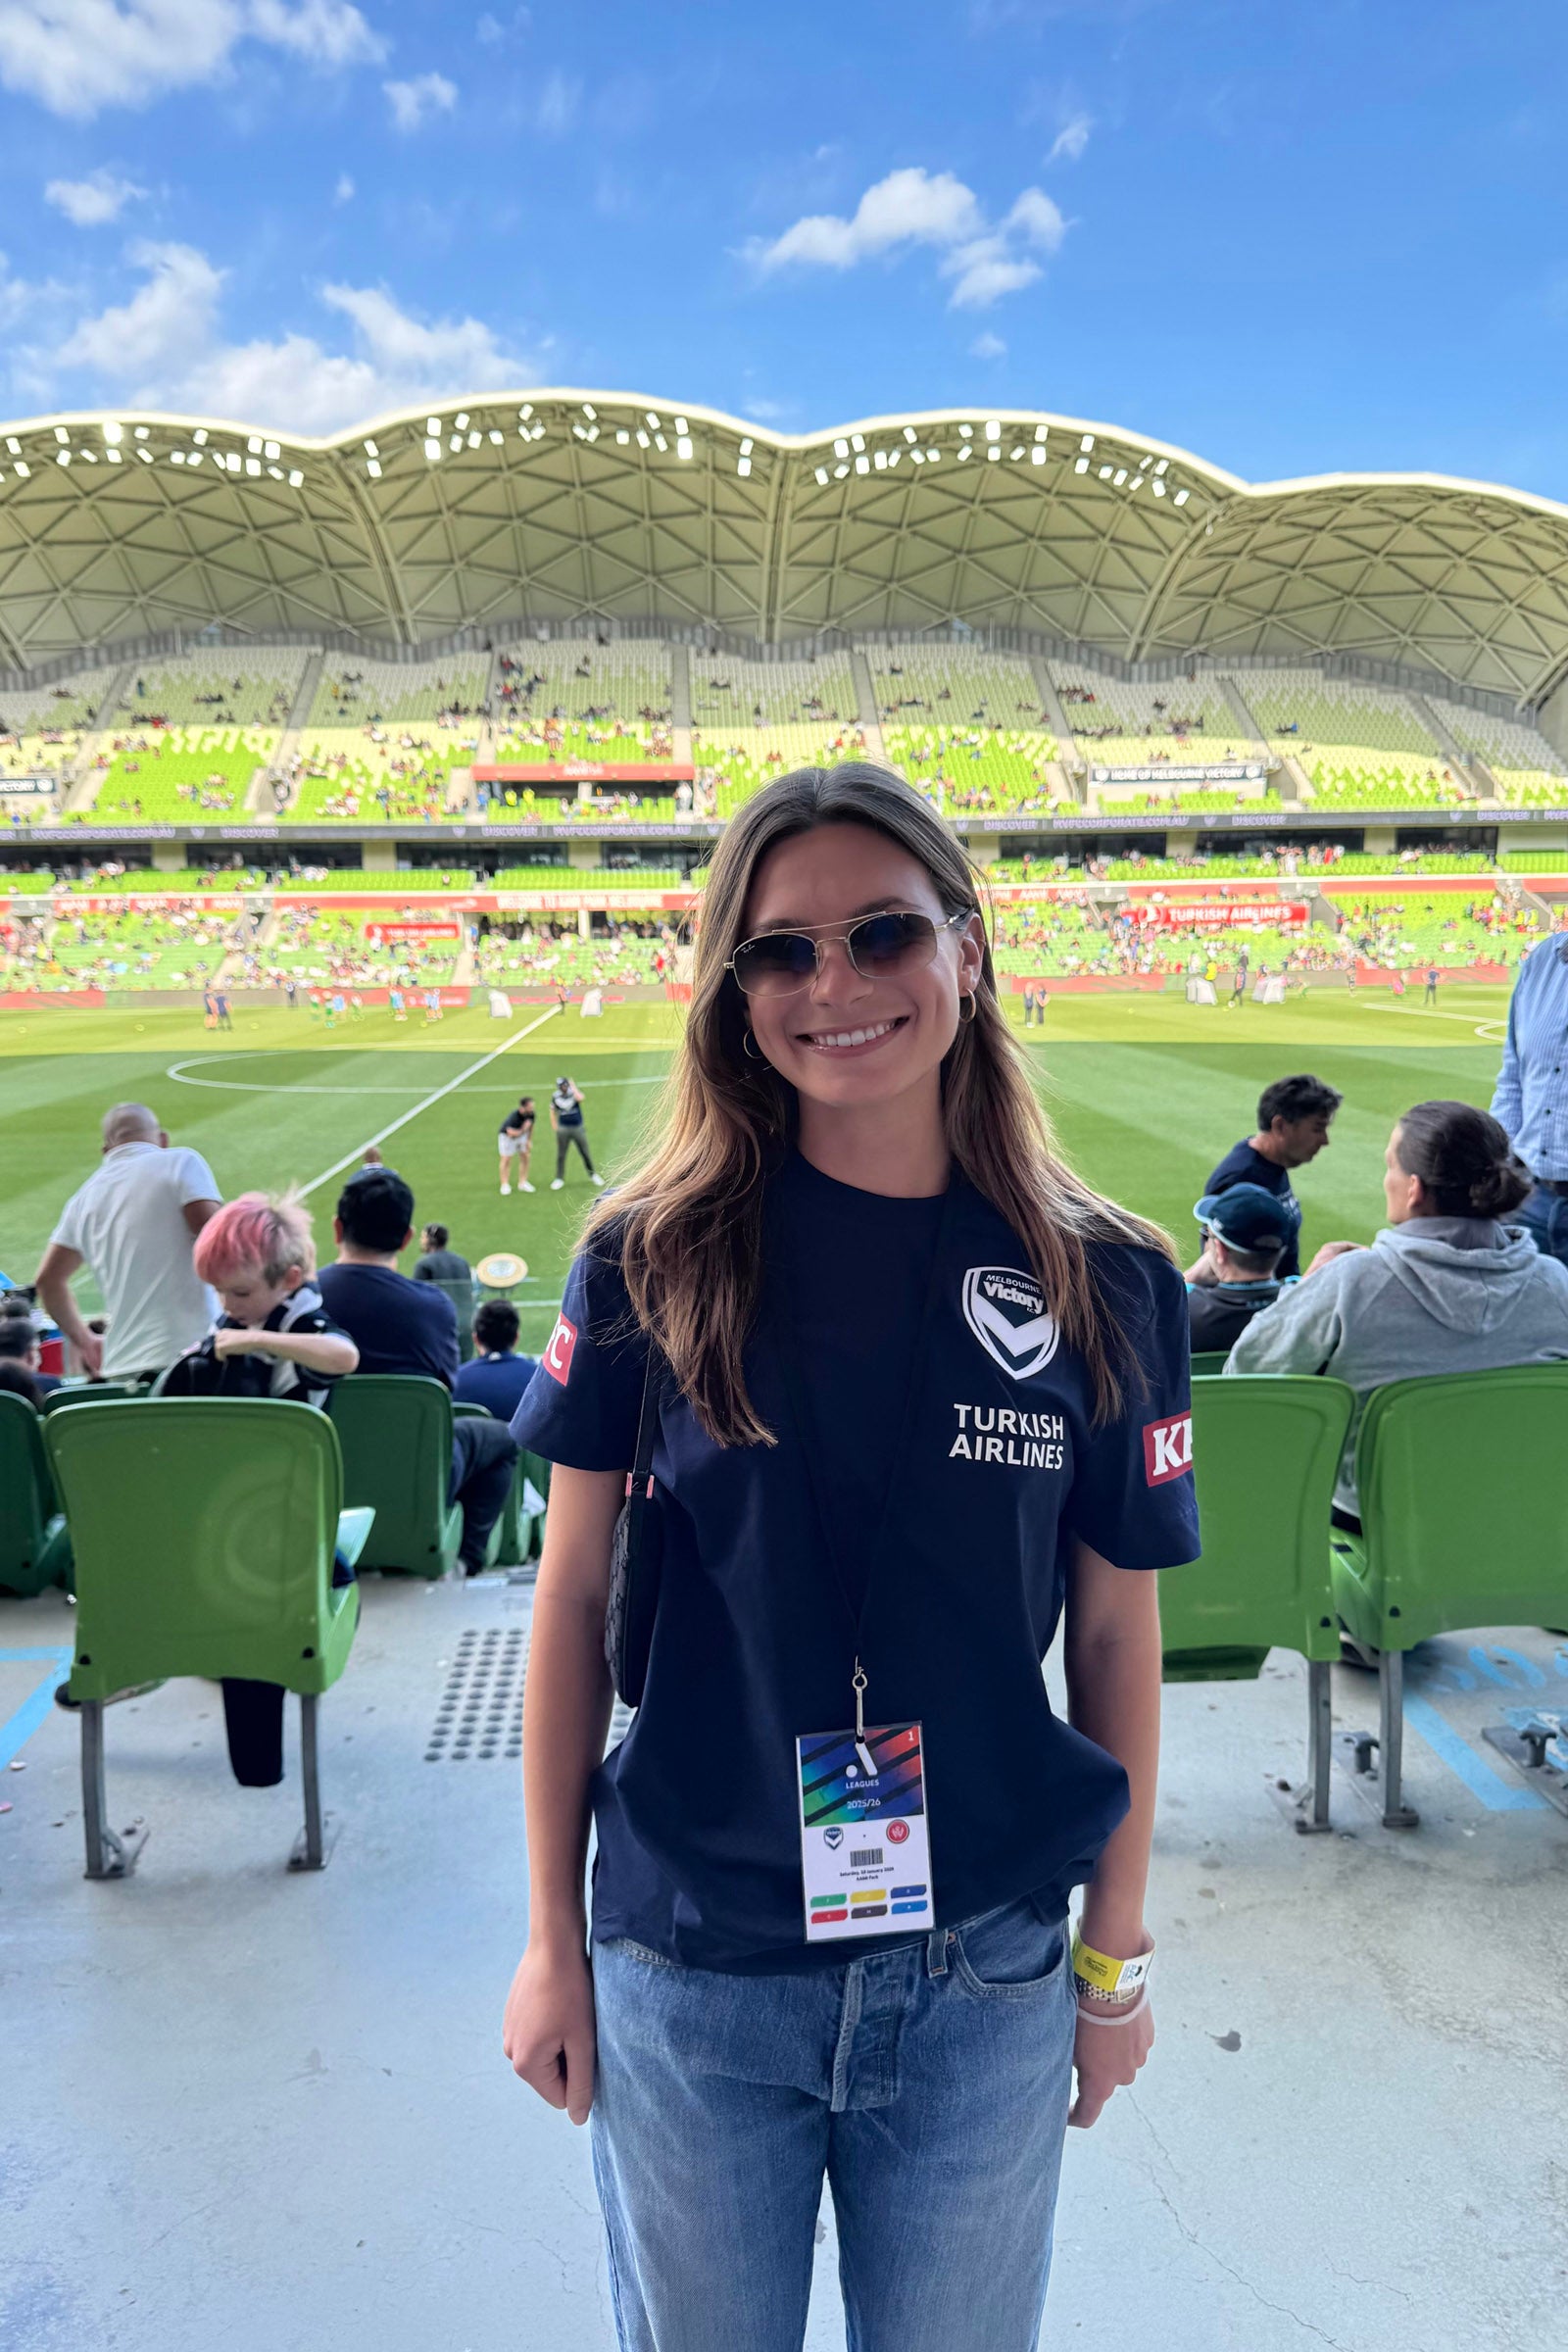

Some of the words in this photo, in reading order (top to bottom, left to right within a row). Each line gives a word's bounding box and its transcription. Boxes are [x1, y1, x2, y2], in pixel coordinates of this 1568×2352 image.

[1110, 769, 1136, 780] HOME
[1138, 768, 1151, 780] OF
[1205, 766, 1246, 779] VICTORY
[1232, 814, 1287, 826] DISCOVER
[1169, 907, 1229, 922] TURKISH
[985, 1274, 1042, 1295] MELBOURNE
[954, 1403, 1064, 1441] TURKISH
[949, 1434, 1064, 1470] AIRLINES
[907, 1731, 914, 1741] 1
[846, 1779, 880, 1789] LEAGUES
[847, 1798, 881, 1809] 2025/26
